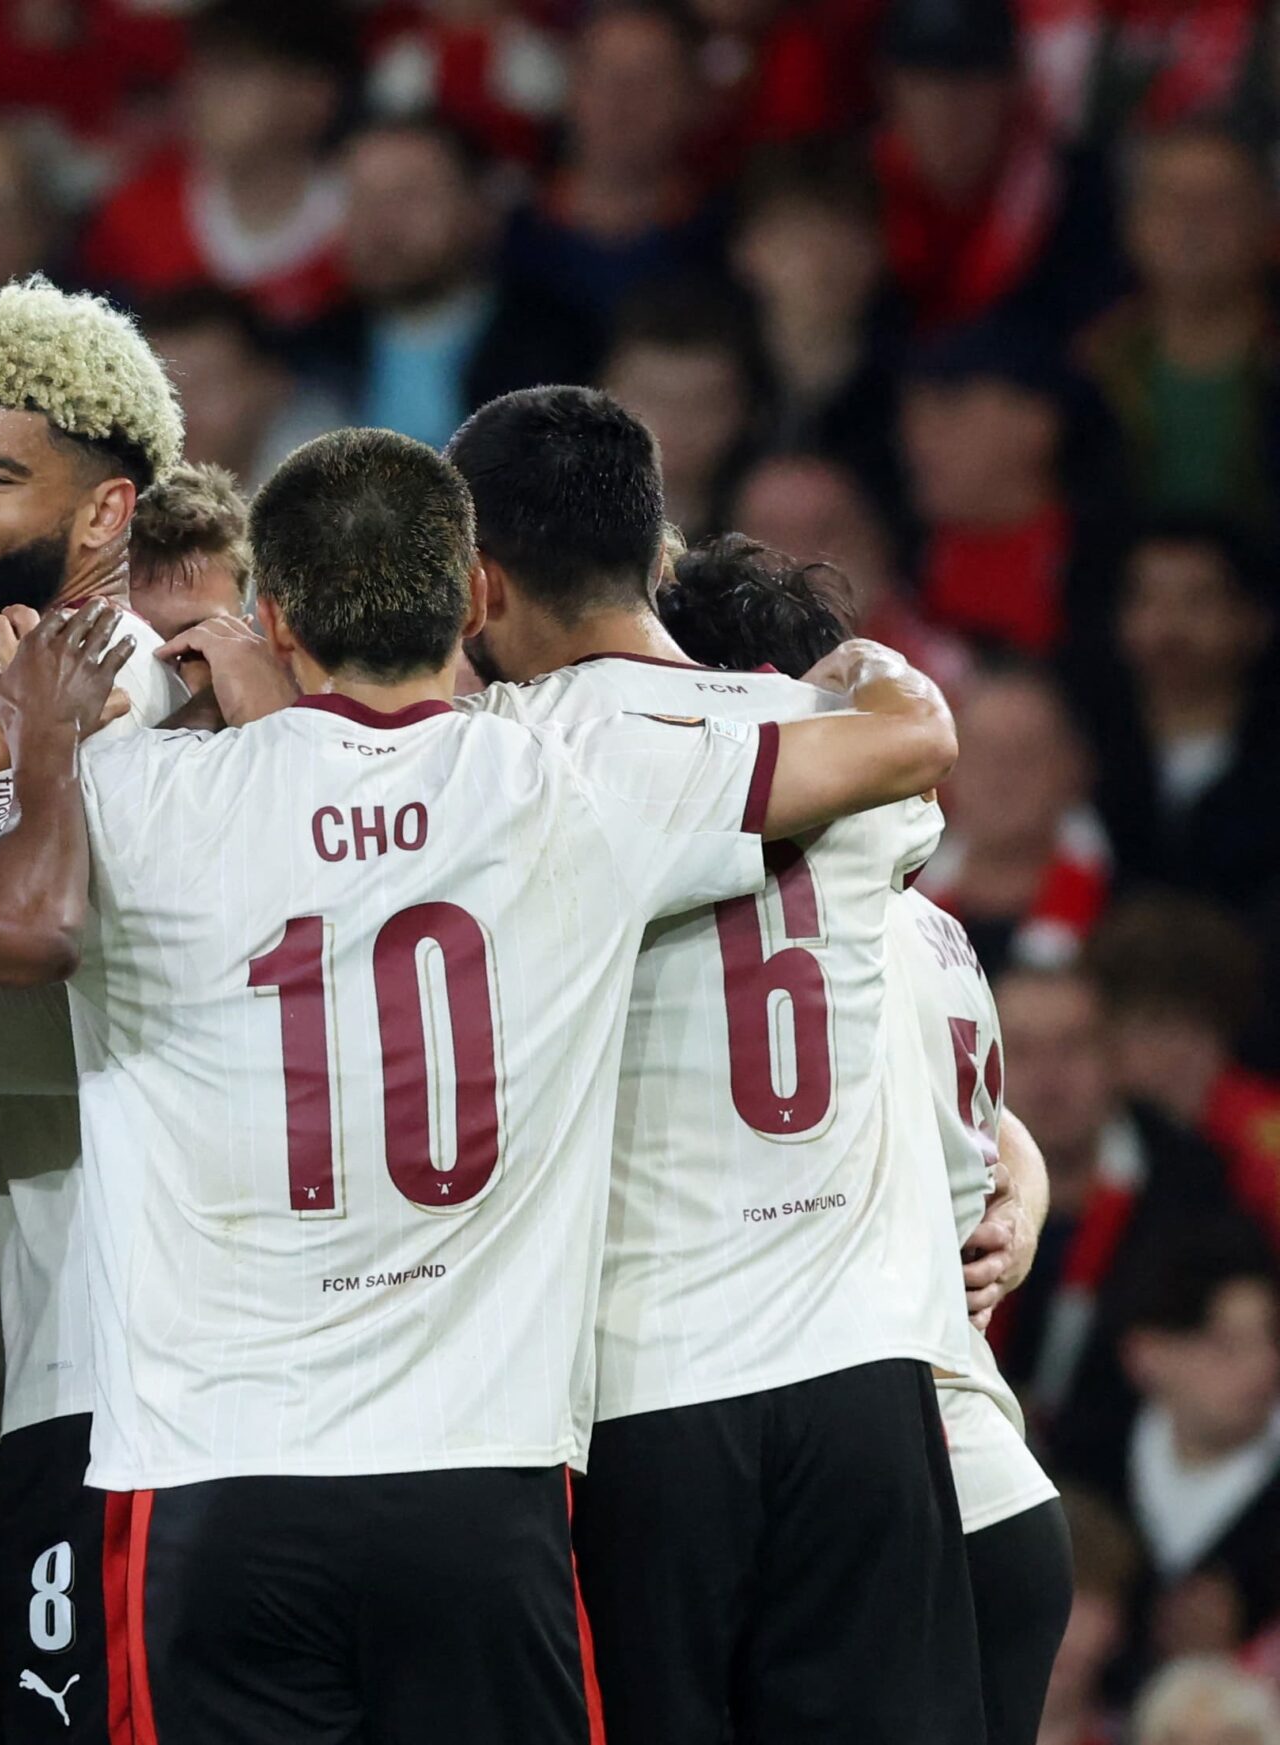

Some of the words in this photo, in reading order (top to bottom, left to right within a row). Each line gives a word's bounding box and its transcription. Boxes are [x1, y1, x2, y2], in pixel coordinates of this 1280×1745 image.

[695, 682, 749, 695] FCM
[342, 740, 397, 756] FCM
[311, 801, 428, 863] CHO
[715, 840, 836, 1142] 6
[247, 900, 506, 1220] 10
[742, 1207, 777, 1222] FCM
[782, 1193, 846, 1215] SAMFUND
[322, 1277, 360, 1292] FCM
[365, 1264, 446, 1288] SAMFUND
[29, 1540, 76, 1654] 8
